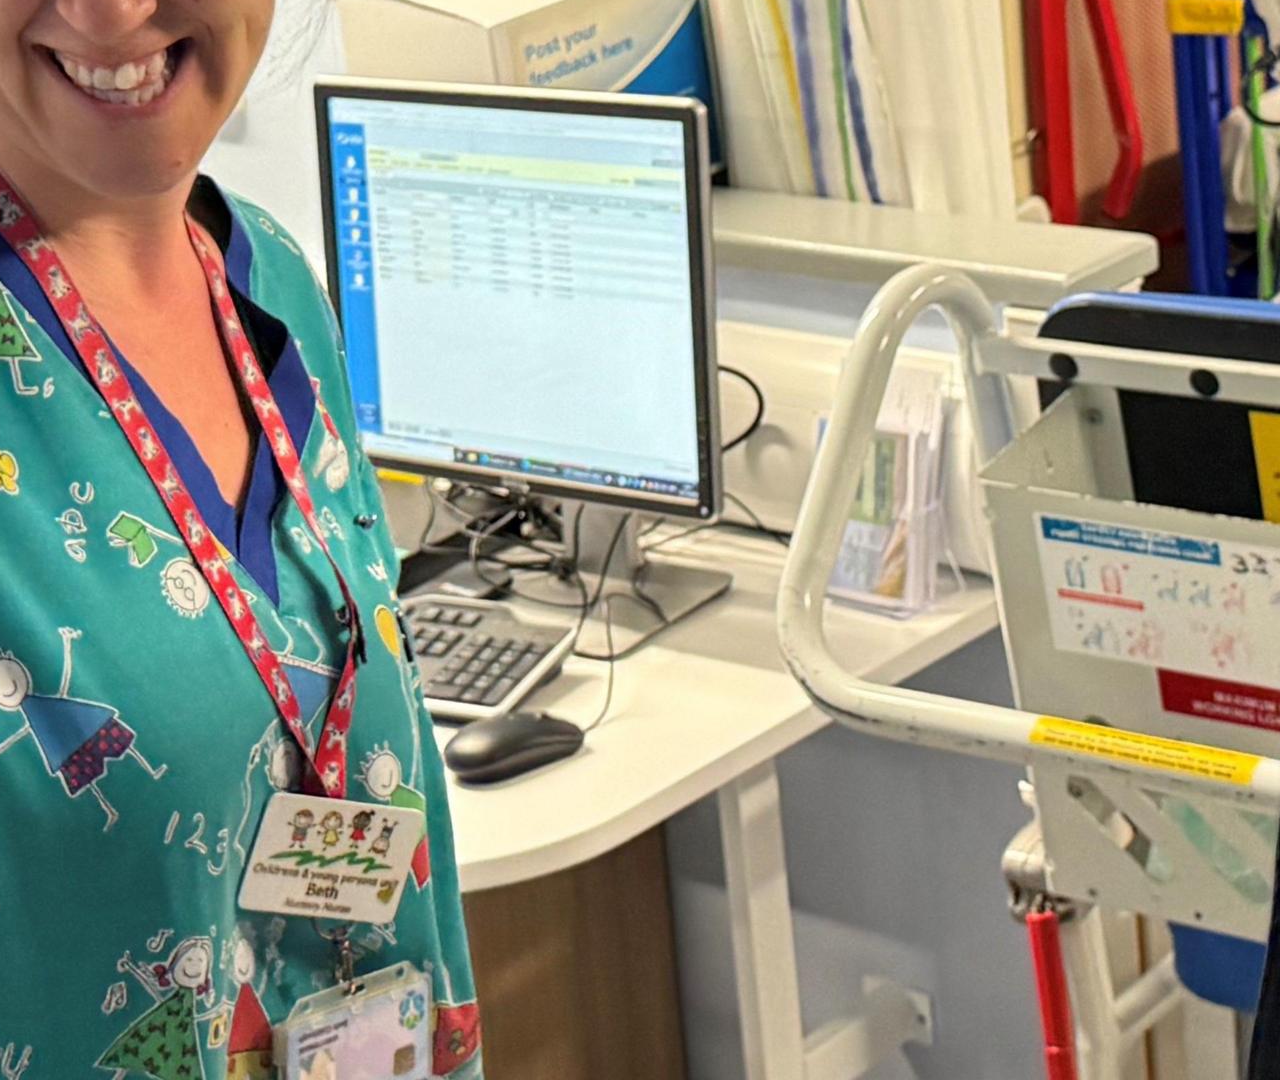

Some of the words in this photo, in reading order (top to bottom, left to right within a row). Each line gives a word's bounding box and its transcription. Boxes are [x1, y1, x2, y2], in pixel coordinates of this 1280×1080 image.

[524, 36, 561, 62] Post
[563, 24, 598, 53] your
[528, 48, 598, 87] feedback
[602, 36, 634, 59] here
[1191, 700, 1256, 723] WORKING
[301, 868, 310, 879] &
[310, 869, 340, 884] young
[305, 882, 339, 900] Beth
[322, 901, 352, 914] Nurse
